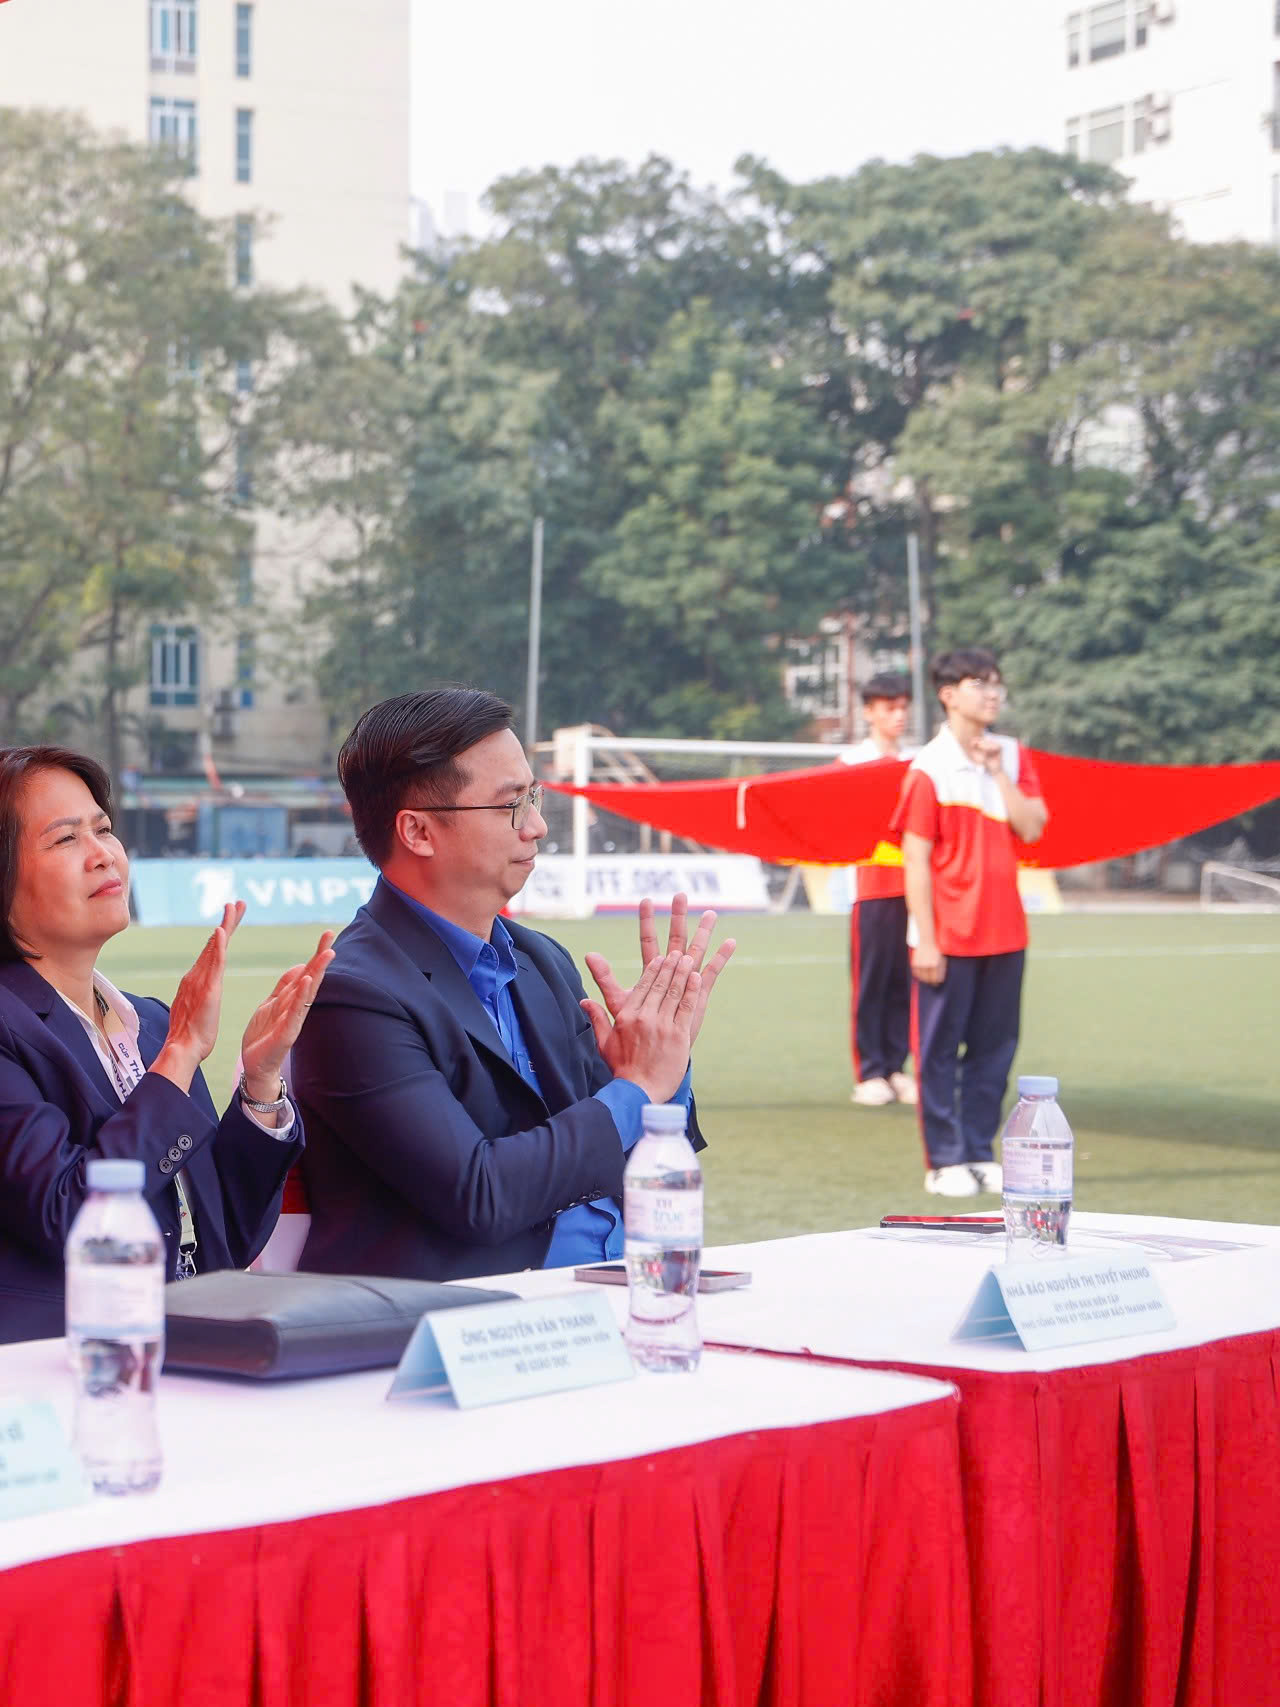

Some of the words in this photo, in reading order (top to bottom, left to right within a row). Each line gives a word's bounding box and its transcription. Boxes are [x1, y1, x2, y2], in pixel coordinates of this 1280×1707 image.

[243, 875, 375, 907] VNPT
[118, 1042, 130, 1059] CÚP
[129, 1059, 144, 1081] TH
